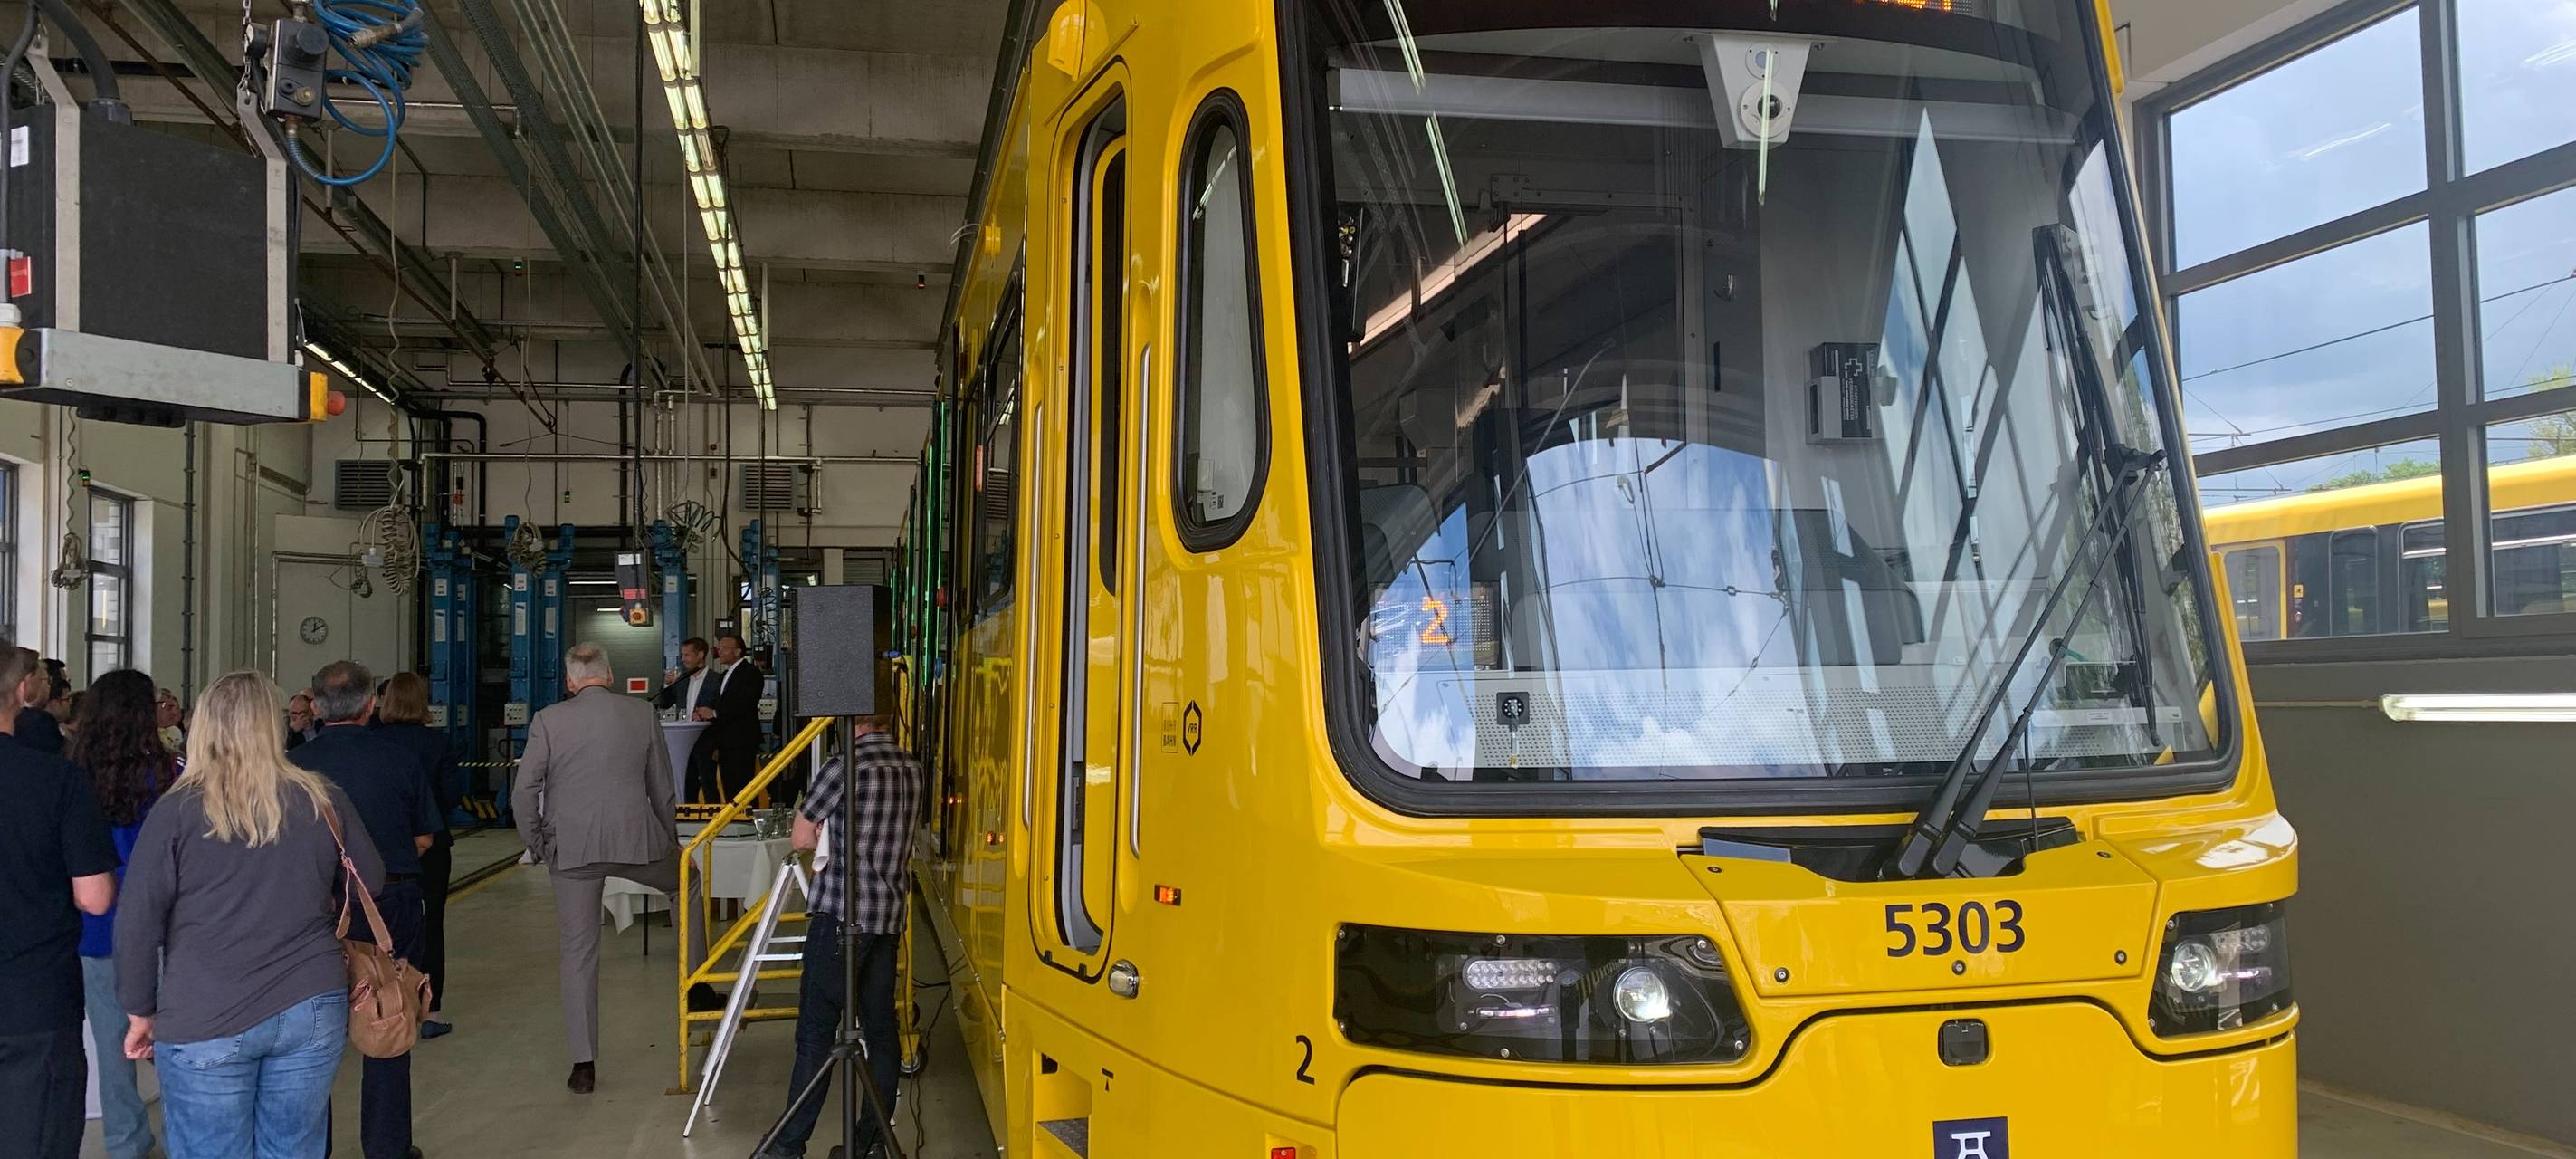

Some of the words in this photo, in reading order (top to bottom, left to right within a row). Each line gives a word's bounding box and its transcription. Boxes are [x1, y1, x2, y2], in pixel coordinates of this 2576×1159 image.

[1422, 599, 1448, 643] 2
[1188, 723, 1197, 733] VRR
[1885, 899, 2026, 958] 5303
[1296, 1034, 1315, 1085] 2
